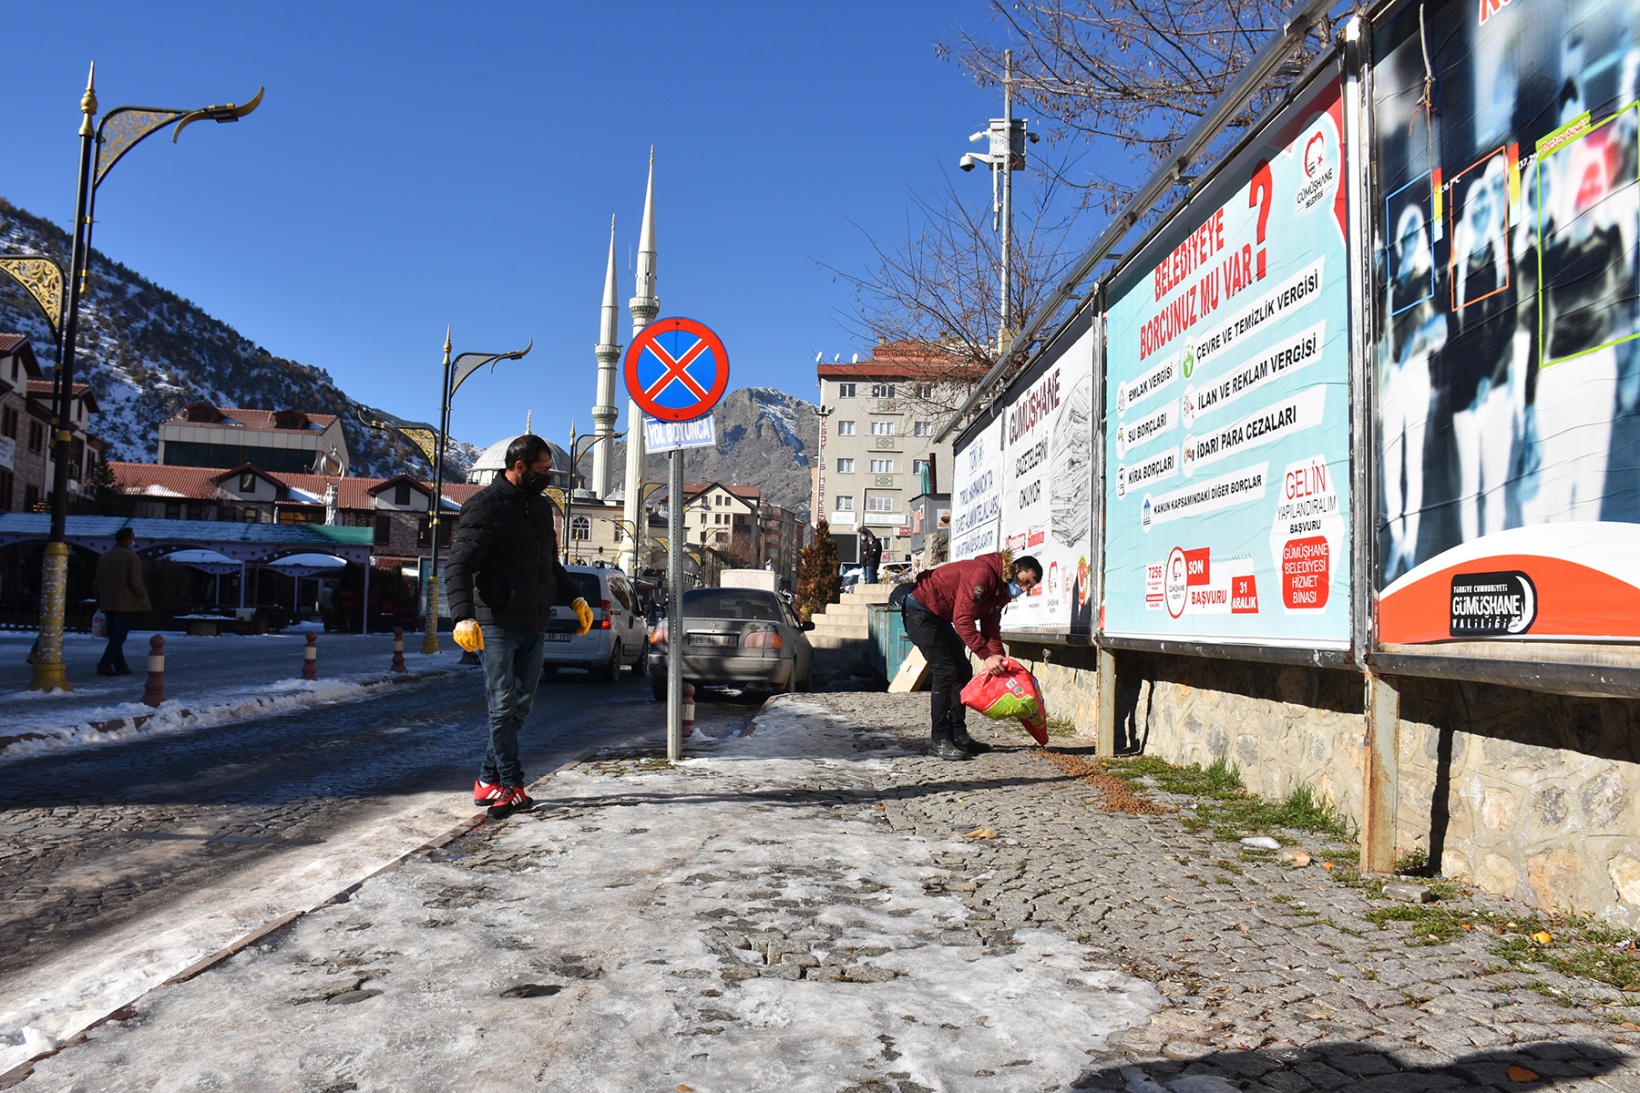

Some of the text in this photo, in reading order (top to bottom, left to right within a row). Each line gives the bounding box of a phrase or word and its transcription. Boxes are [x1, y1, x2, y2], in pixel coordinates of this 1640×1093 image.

[1154, 207, 1225, 303] BELEDİYEYE
[1140, 285, 1197, 361] BORCUNUZ
[1199, 266, 1220, 319] MU
[1196, 268, 1319, 364] ÇEVRE VE TEMİZLİK VERGİSİ
[1128, 361, 1173, 402] EMLAK VERGİSİ
[1198, 332, 1317, 411] İLAN VE REKLAM VERGİSİ
[1009, 367, 1061, 446] GÜMÜŞHANE
[647, 418, 711, 446] YOL BOYUNCA
[1128, 412, 1167, 443] SU BORÇLARI
[1196, 404, 1297, 457] İDARİ PARA CEZALARI
[1015, 430, 1049, 479] GAZETELERİNİ
[1129, 455, 1175, 485] KİRA BORÇLARI
[1285, 460, 1326, 500] GELİN
[1019, 479, 1041, 510] OKUYOR
[1153, 474, 1262, 515] KANUN KAPSAMINDAKİ DİĞER BORÇLAR
[1277, 495, 1337, 521] YAPILANDIRALIM
[1289, 519, 1321, 535] BAŞVURU
[1283, 542, 1329, 561] GÜMÜŞHANE
[1148, 565, 1162, 579] 7256
[1188, 559, 1204, 575] SON
[1284, 558, 1327, 575] BELEDİYESİ
[1239, 581, 1248, 594] 31
[1291, 574, 1319, 588] HİZMET
[1191, 589, 1227, 608] BAŞVURU
[1231, 596, 1256, 609] ARALIK
[1292, 590, 1317, 604] BİNASI
[1452, 594, 1521, 619] GÜMÜŞHANE
[1452, 616, 1507, 629] VALİLİĞİ
